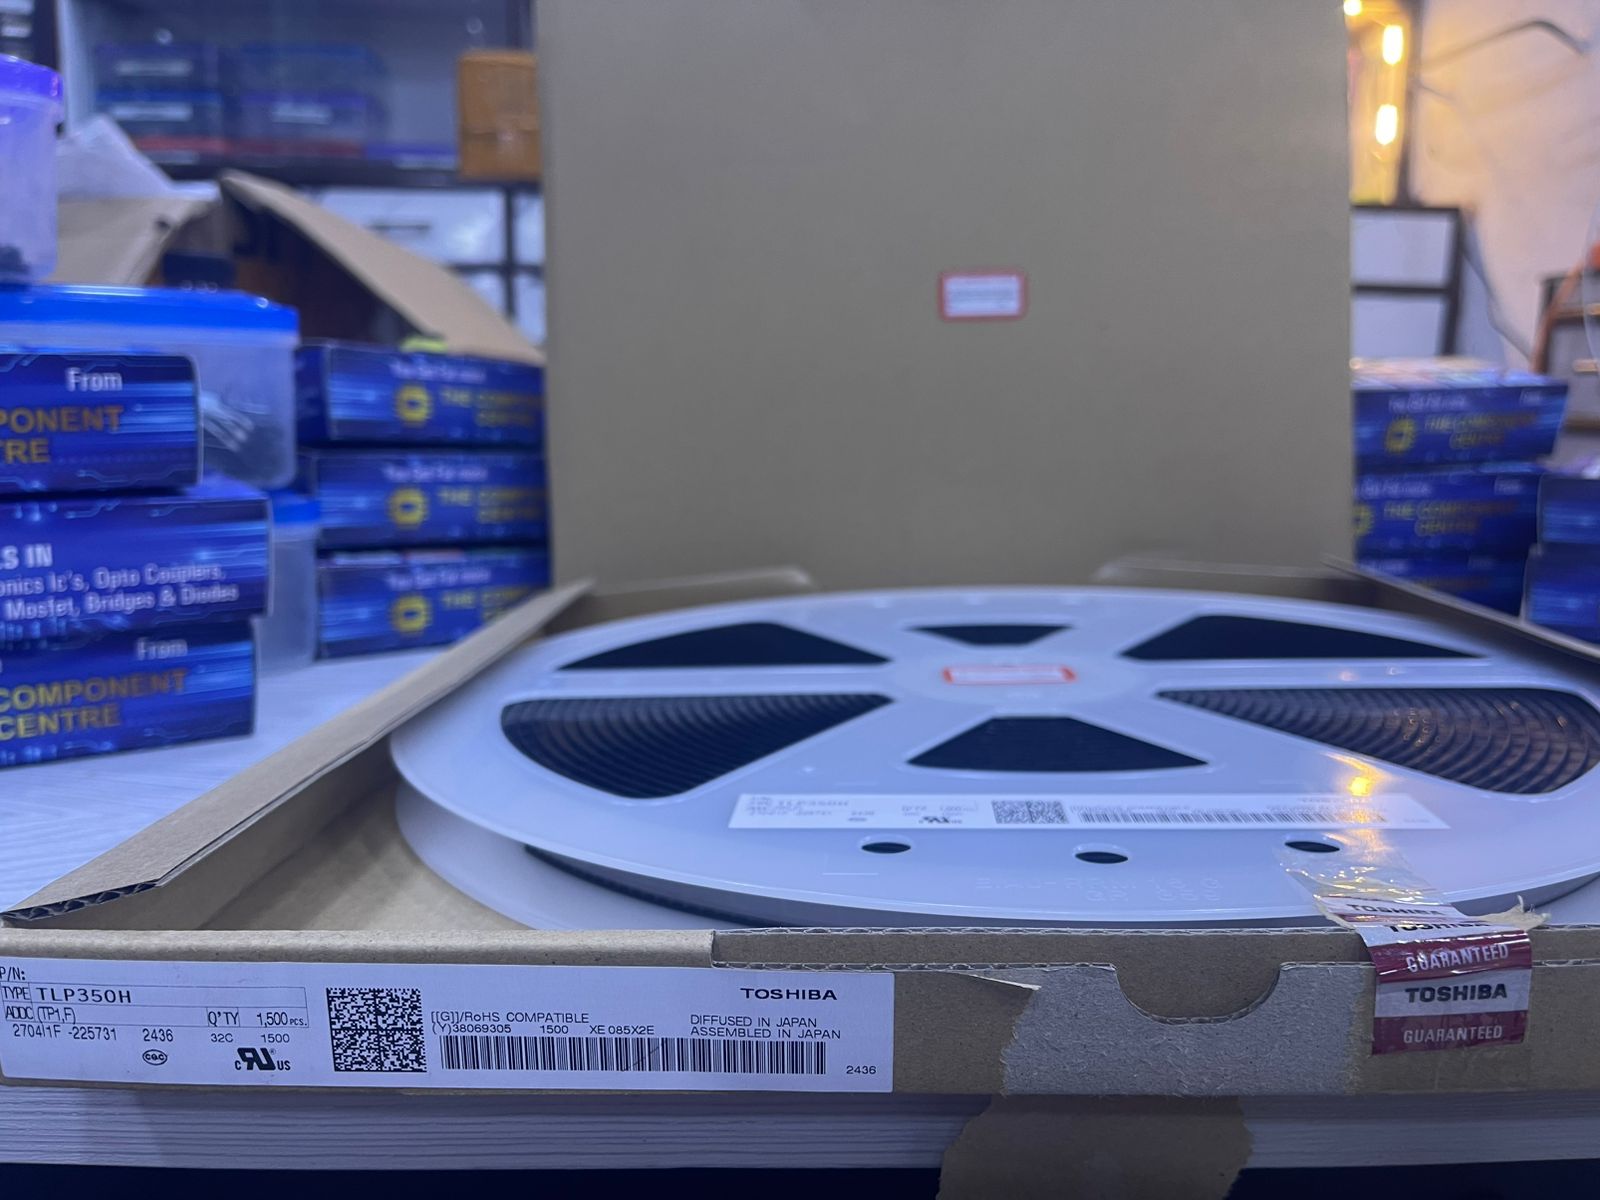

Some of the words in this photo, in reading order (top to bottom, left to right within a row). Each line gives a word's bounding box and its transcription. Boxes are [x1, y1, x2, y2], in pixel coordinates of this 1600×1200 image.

[66, 367, 123, 391] From
[0, 545, 19, 570] S
[25, 543, 53, 569] IN
[137, 637, 188, 661] From
[1348, 903, 1445, 916] TOSHIBA
[1406, 943, 1509, 973] GUARANTEED
[0, 966, 26, 981] P/N:
[2, 985, 30, 1000] TYPE
[36, 987, 132, 1003] TLP350H
[740, 987, 838, 1001] TOSHIBA
[1404, 983, 1508, 1004] TOSHIBA
[5, 1006, 34, 1020] ADDC
[256, 1012, 288, 1028] 1,500
[506, 1012, 590, 1024] COMPATIBLE
[690, 1014, 753, 1027] DIFFUSED
[758, 1017, 771, 1027] IN
[776, 1017, 818, 1029] JAPAN
[68, 1026, 118, 1041] -225731
[142, 1028, 174, 1042] 2436
[210, 1033, 234, 1043] 32C
[260, 1033, 290, 1044] 1500
[540, 1025, 570, 1035] 1500
[690, 1026, 772, 1039] ASSEMBLED
[778, 1029, 791, 1038] IN
[797, 1029, 841, 1040] JAPAN
[1403, 1025, 1503, 1045] GUARANTEED
[846, 1065, 877, 1076] 2436
